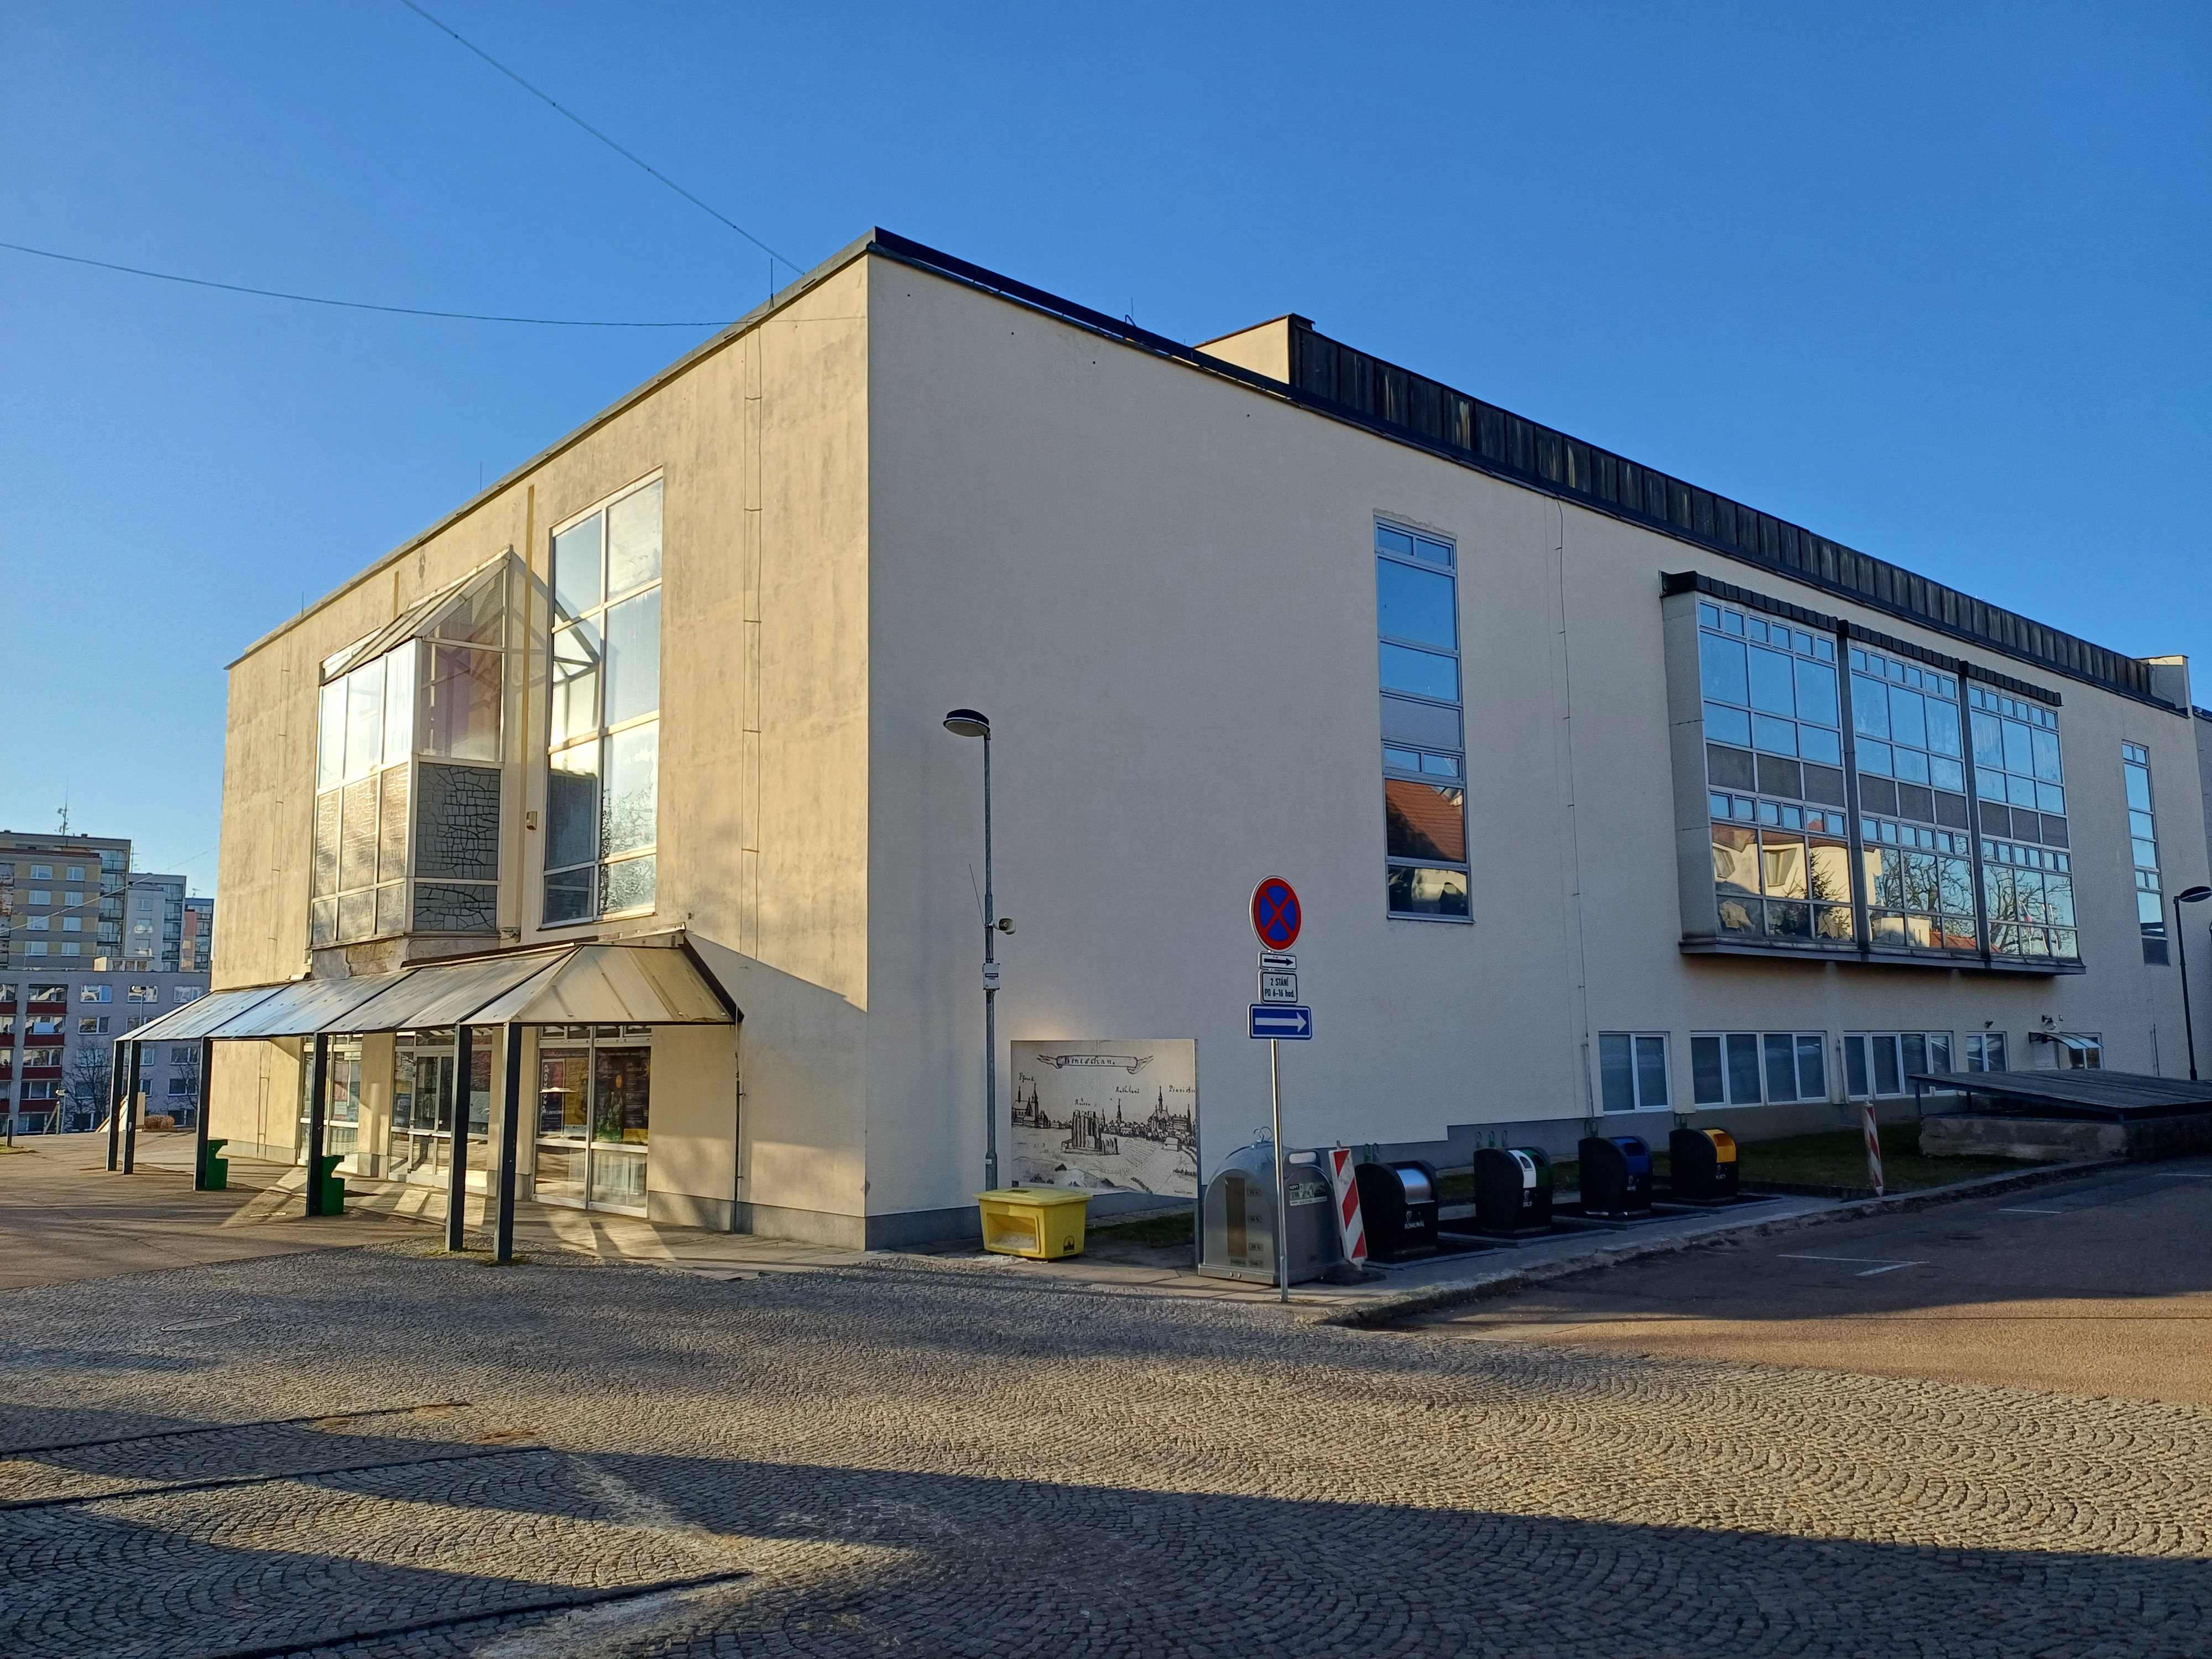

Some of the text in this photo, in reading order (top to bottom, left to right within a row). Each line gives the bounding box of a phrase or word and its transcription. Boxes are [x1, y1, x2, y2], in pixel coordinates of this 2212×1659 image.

[1270, 977, 1289, 987] 2 STÁNÍ
[1265, 988, 1295, 998] PO 6-16 hod.
